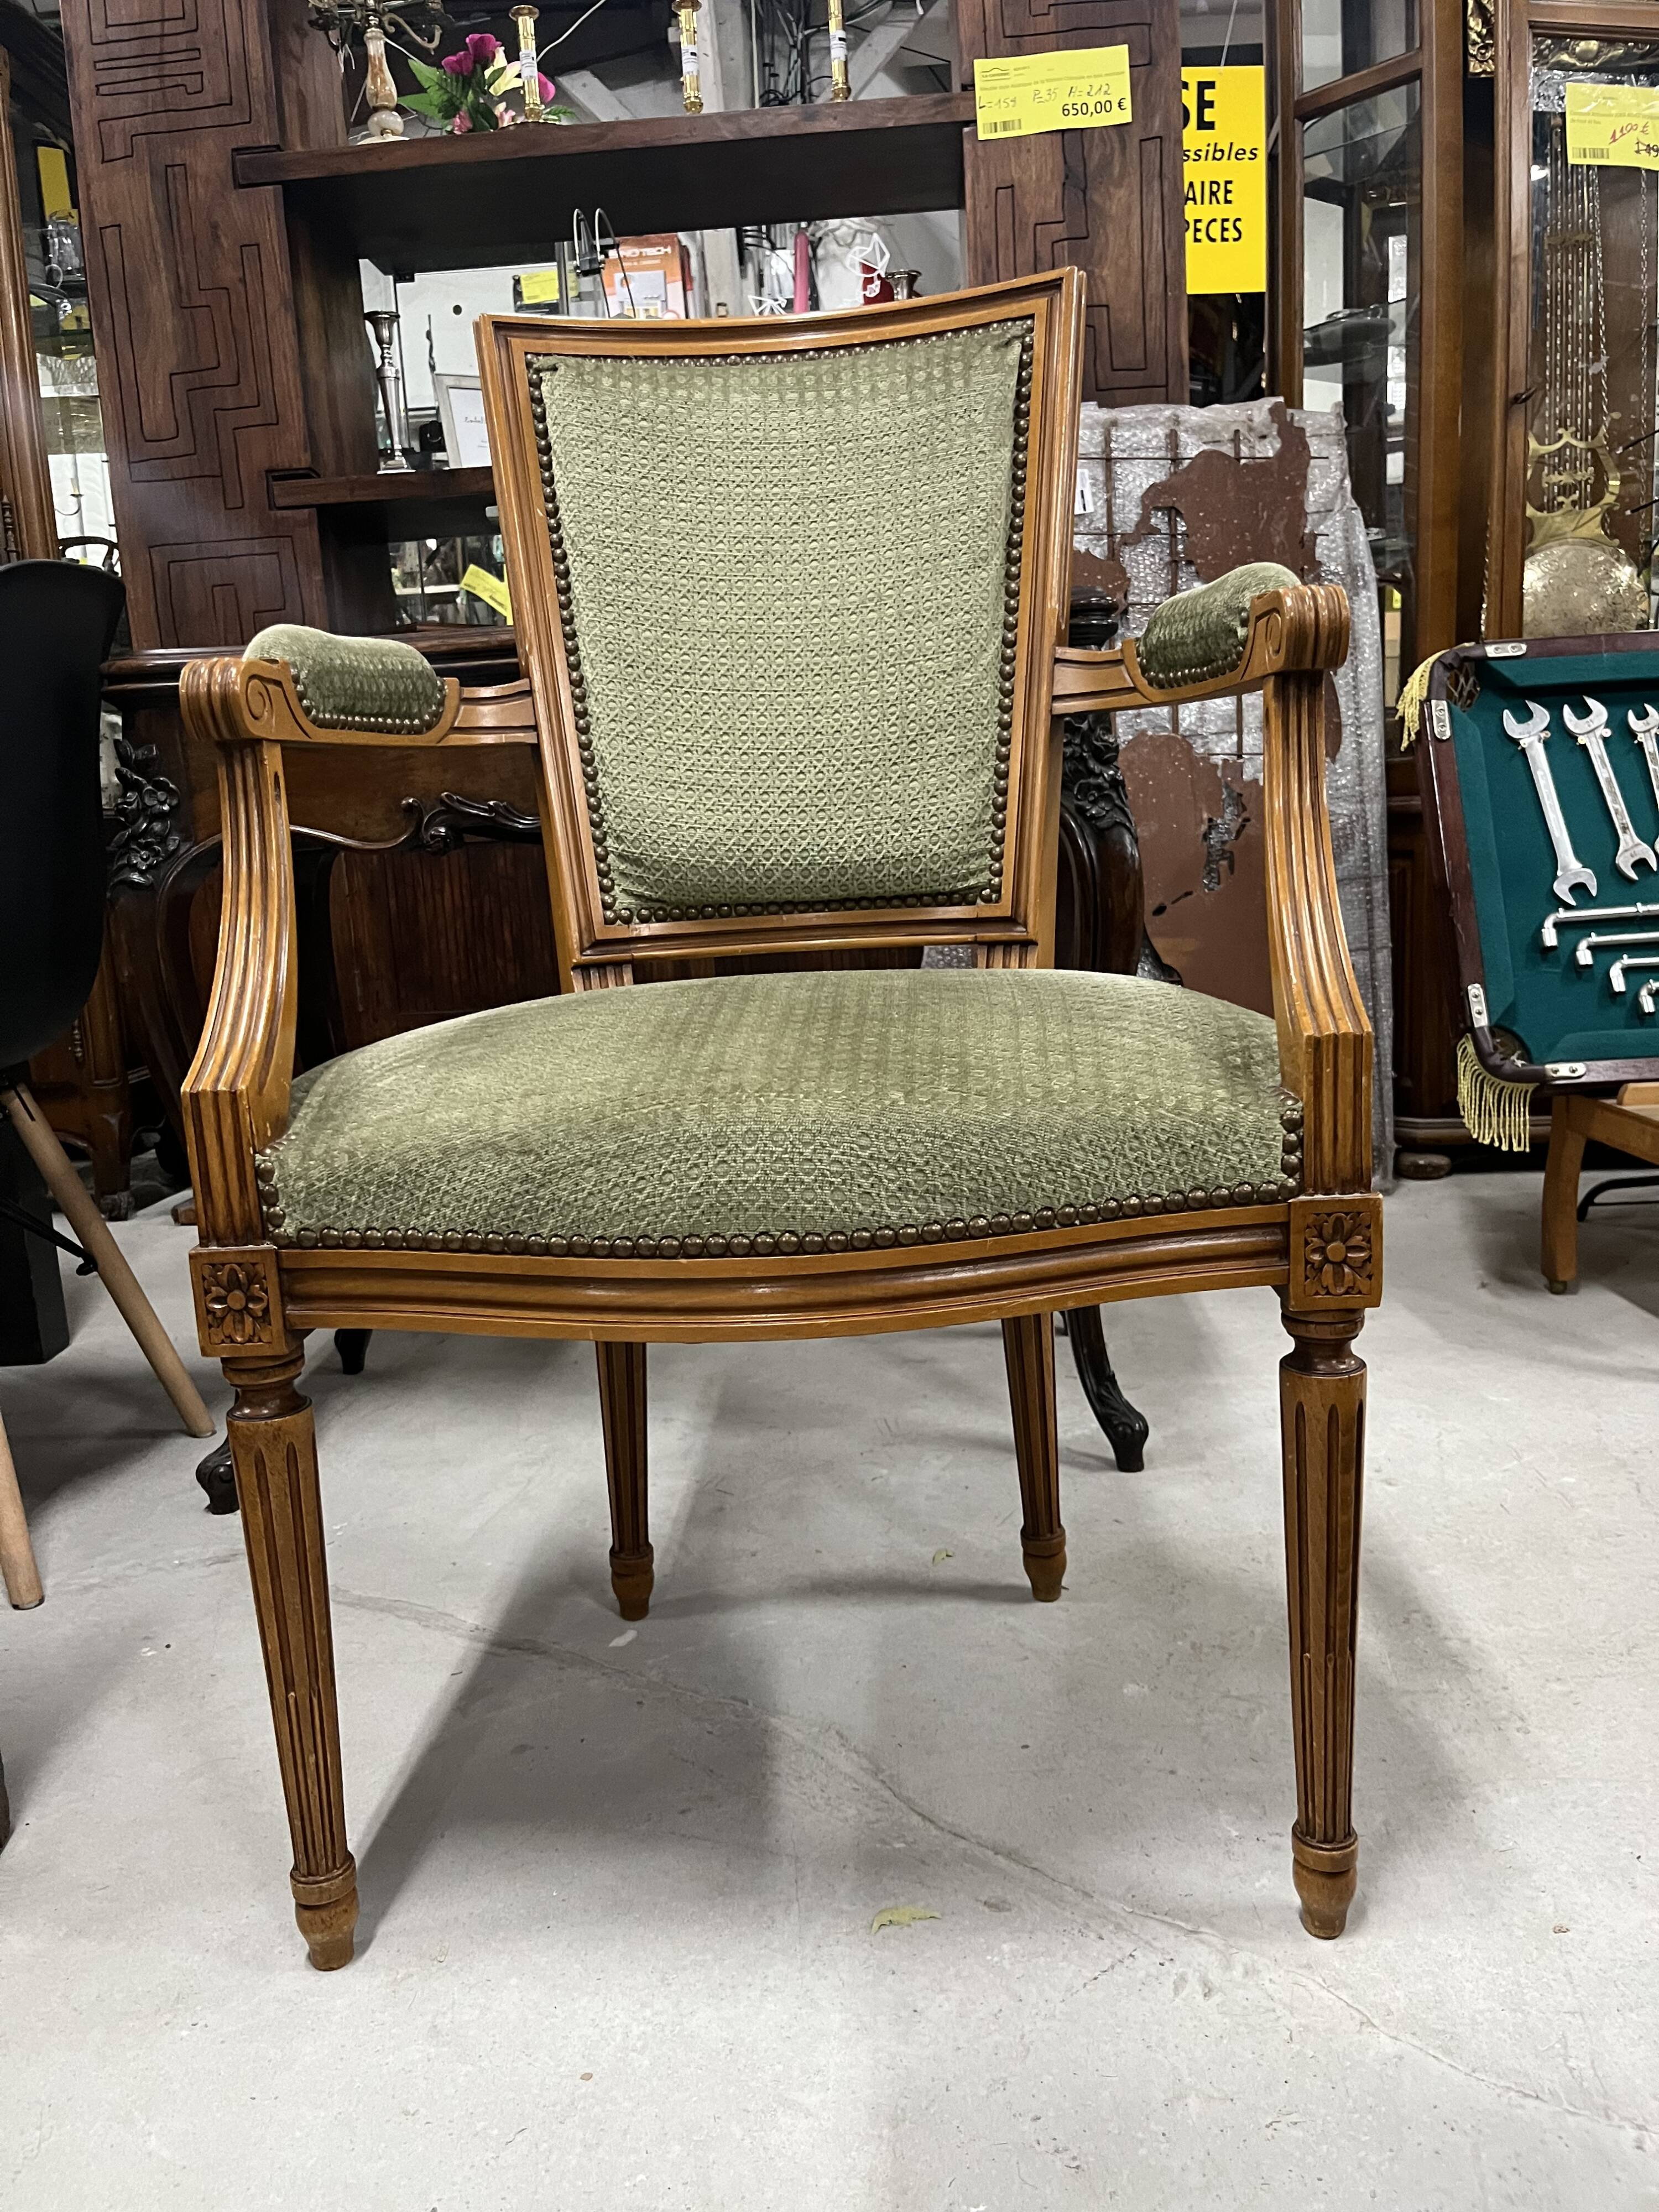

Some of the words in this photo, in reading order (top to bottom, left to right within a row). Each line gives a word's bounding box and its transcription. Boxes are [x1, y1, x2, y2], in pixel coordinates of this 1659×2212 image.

[1062, 100, 1112, 117] 650,00
[1117, 97, 1127, 111] €
[1182, 142, 1259, 162] ssibles
[1185, 180, 1233, 205] AIRE
